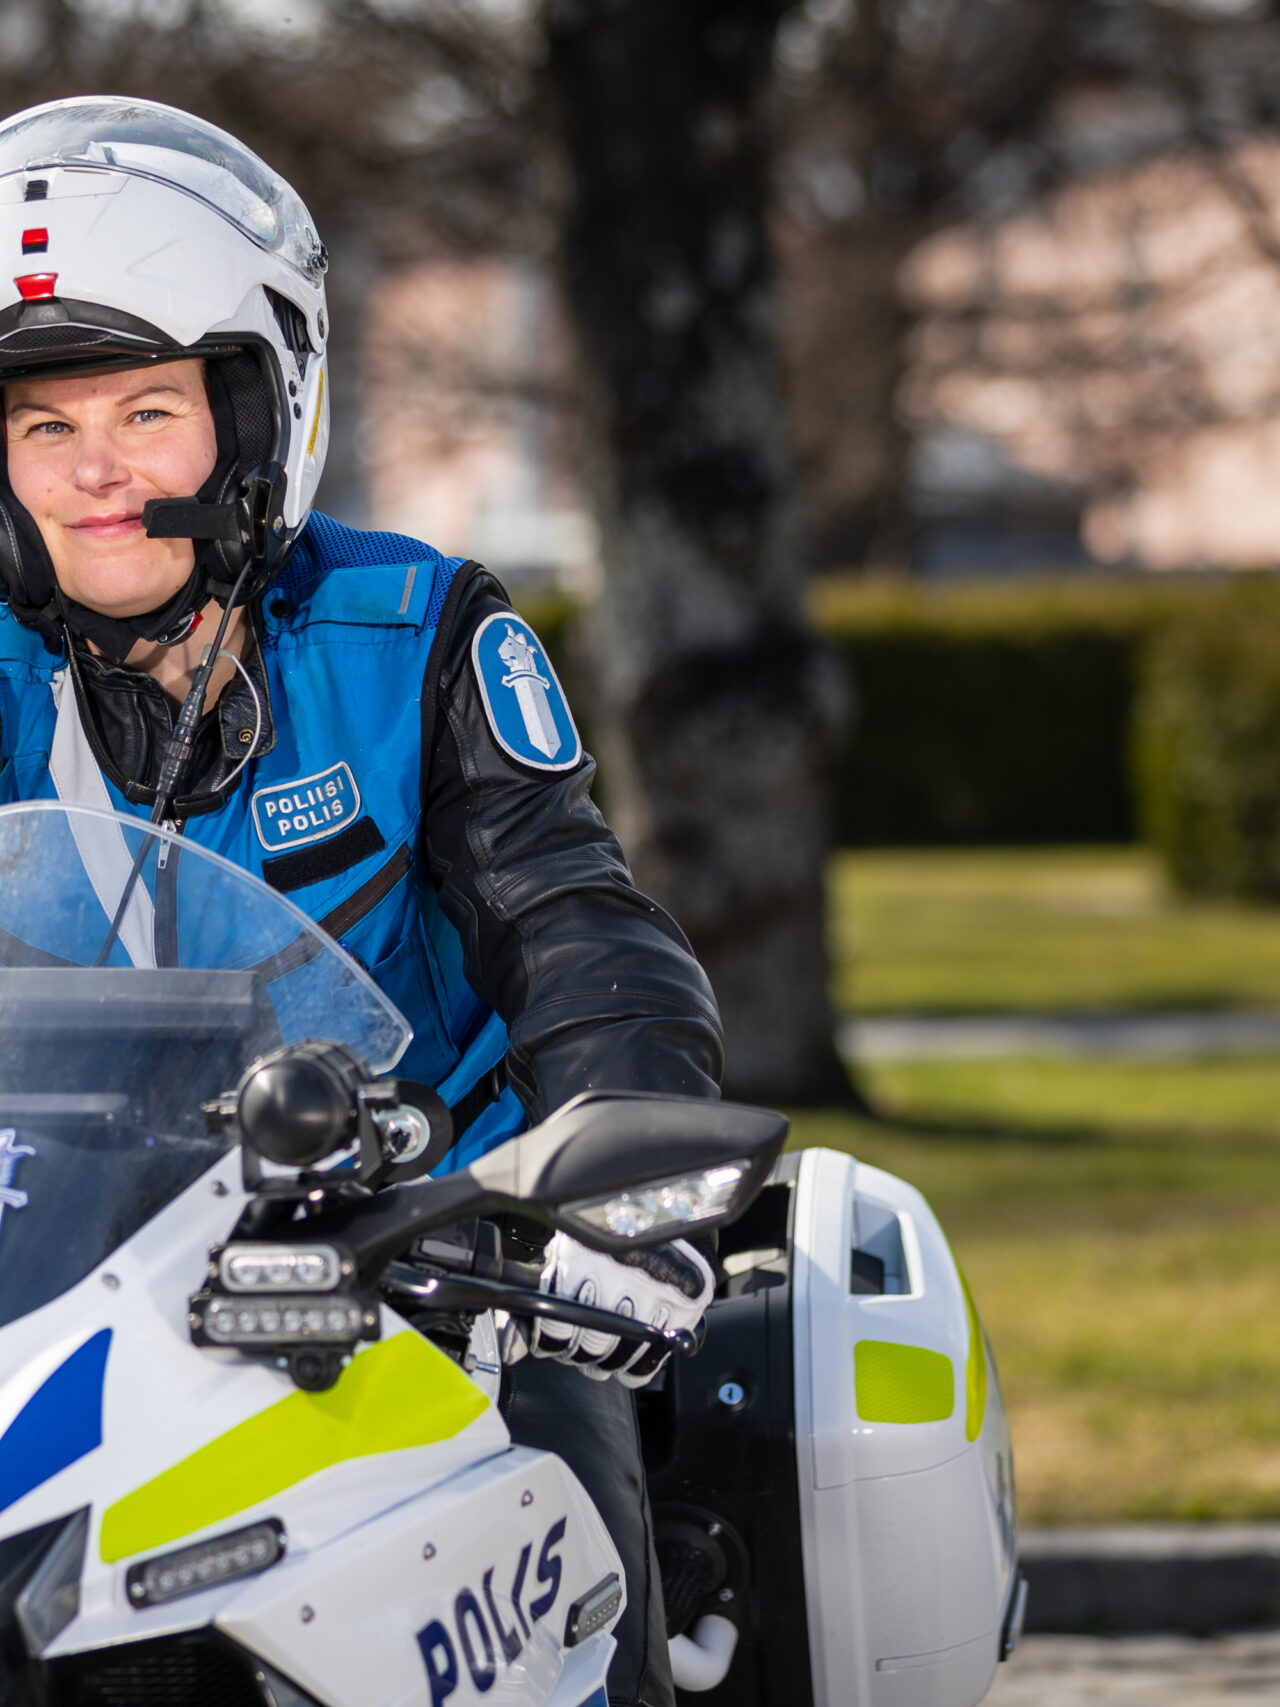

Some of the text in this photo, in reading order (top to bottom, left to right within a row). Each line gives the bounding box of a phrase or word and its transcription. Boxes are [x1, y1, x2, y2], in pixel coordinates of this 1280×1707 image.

[265, 775, 345, 818] POLIISI
[277, 799, 344, 836] POLIS
[414, 1515, 567, 1707] POLIS
